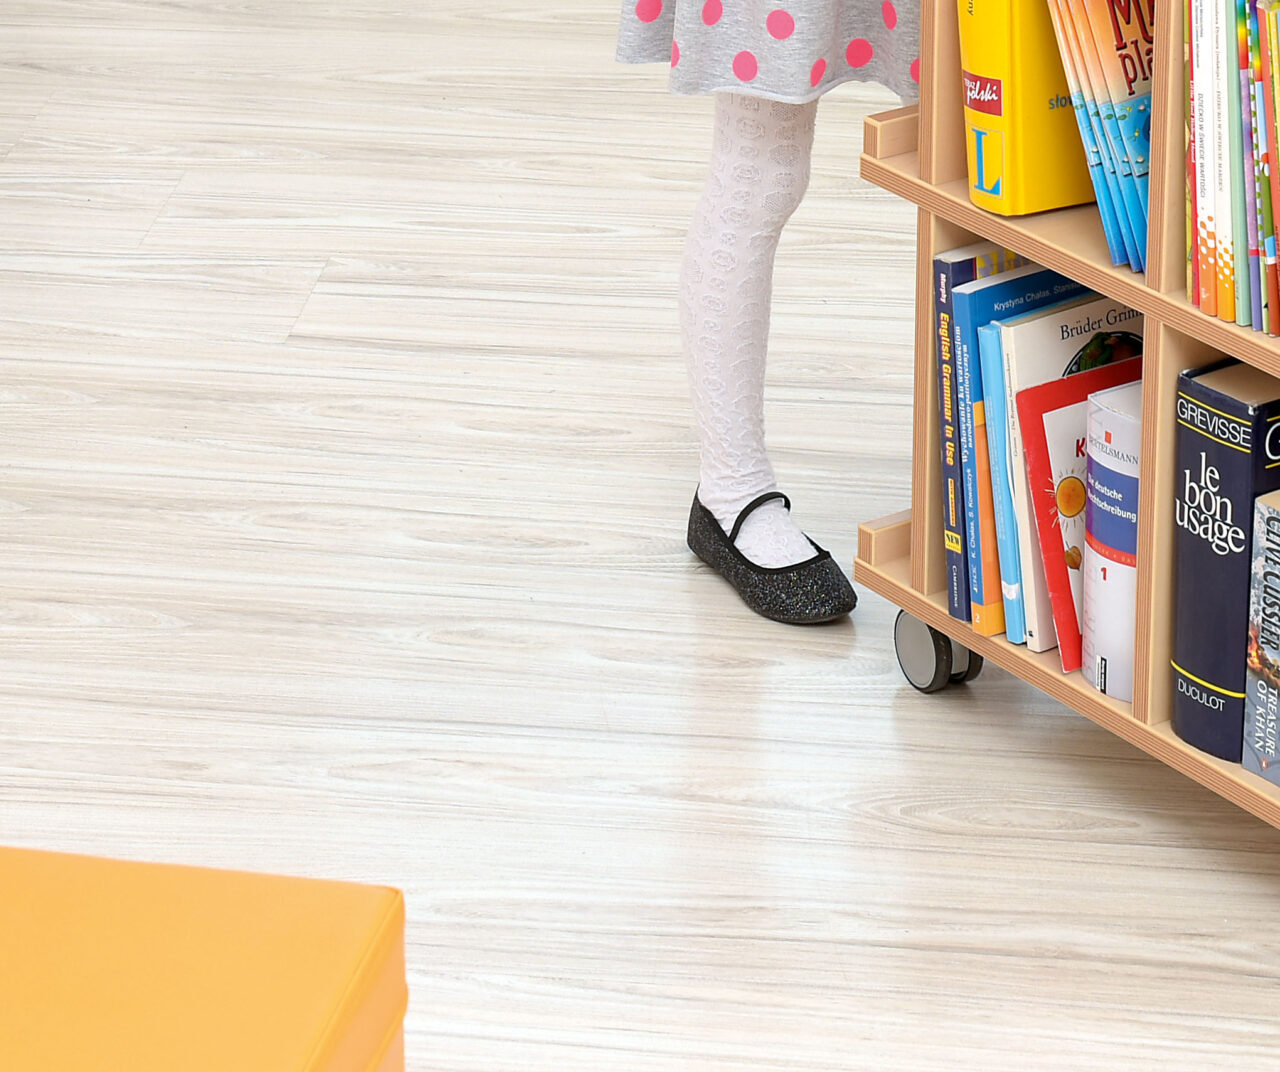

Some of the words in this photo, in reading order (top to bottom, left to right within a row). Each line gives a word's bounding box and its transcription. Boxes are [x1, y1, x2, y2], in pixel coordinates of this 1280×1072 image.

[966, 80, 999, 106] polski
[971, 127, 1002, 196] L
[993, 296, 1024, 312] Krystyna
[939, 312, 951, 360] English
[1060, 317, 1102, 341] Brüder
[942, 363, 953, 422] Grammar
[1176, 398, 1252, 447] GREVISSE
[945, 441, 955, 466] Use
[1200, 451, 1220, 493] le
[1094, 479, 1123, 501] deutsche
[1184, 469, 1234, 525] bon
[1175, 497, 1246, 556] usage
[1100, 566, 1107, 581] 1
[975, 613, 981, 623] 2
[1178, 678, 1226, 712] DUCULOT
[1257, 680, 1267, 703] OF
[1254, 706, 1266, 752] KHAN
[1265, 687, 1278, 757] TREASURE
